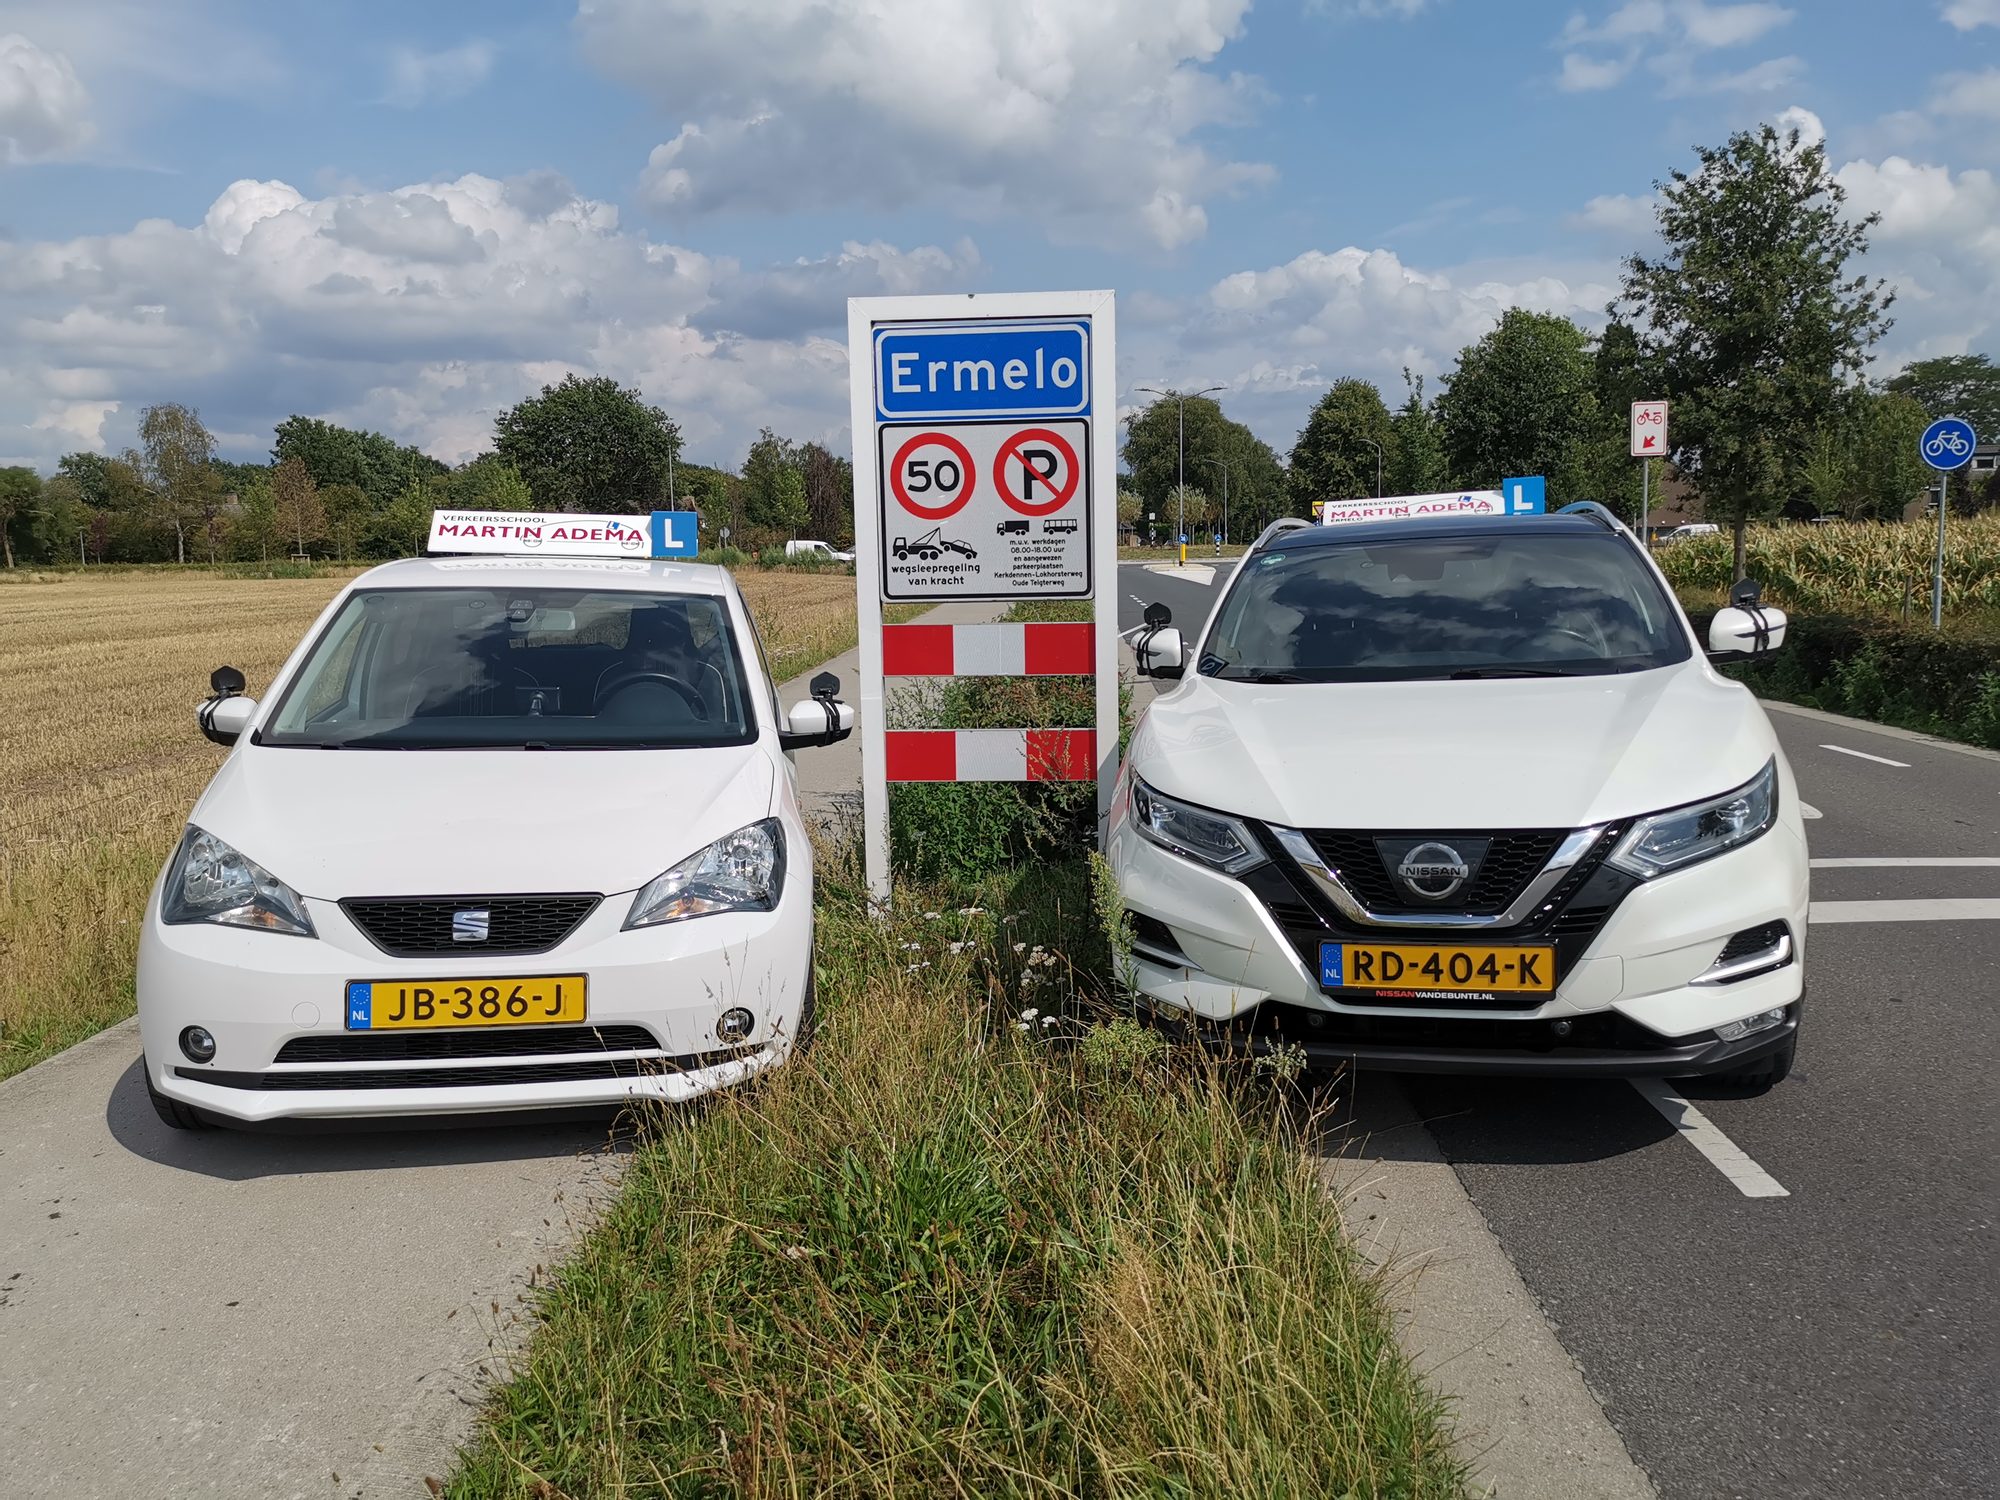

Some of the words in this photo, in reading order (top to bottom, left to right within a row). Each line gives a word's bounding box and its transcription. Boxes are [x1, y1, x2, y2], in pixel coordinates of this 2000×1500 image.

[891, 347, 1077, 393] Ermelo
[907, 460, 960, 492] 50
[1332, 500, 1408, 508] VERKEERSSCHOOL
[1514, 485, 1533, 510] L
[1331, 506, 1409, 518] MARTIN
[1416, 501, 1491, 513] ADEMA
[443, 515, 547, 523] VERKEERSSCHOOL
[438, 524, 542, 539] MARTIN
[551, 527, 643, 541] ADEMA
[664, 518, 684, 548] L
[891, 563, 981, 575] wegsleepregeling
[930, 576, 965, 585] kracht
[1405, 866, 1461, 876] NISSAN
[1325, 968, 1341, 978] NL
[1353, 950, 1542, 984] RD-404-K
[388, 984, 562, 1021] JB-386-J
[352, 1010, 369, 1021] NL
